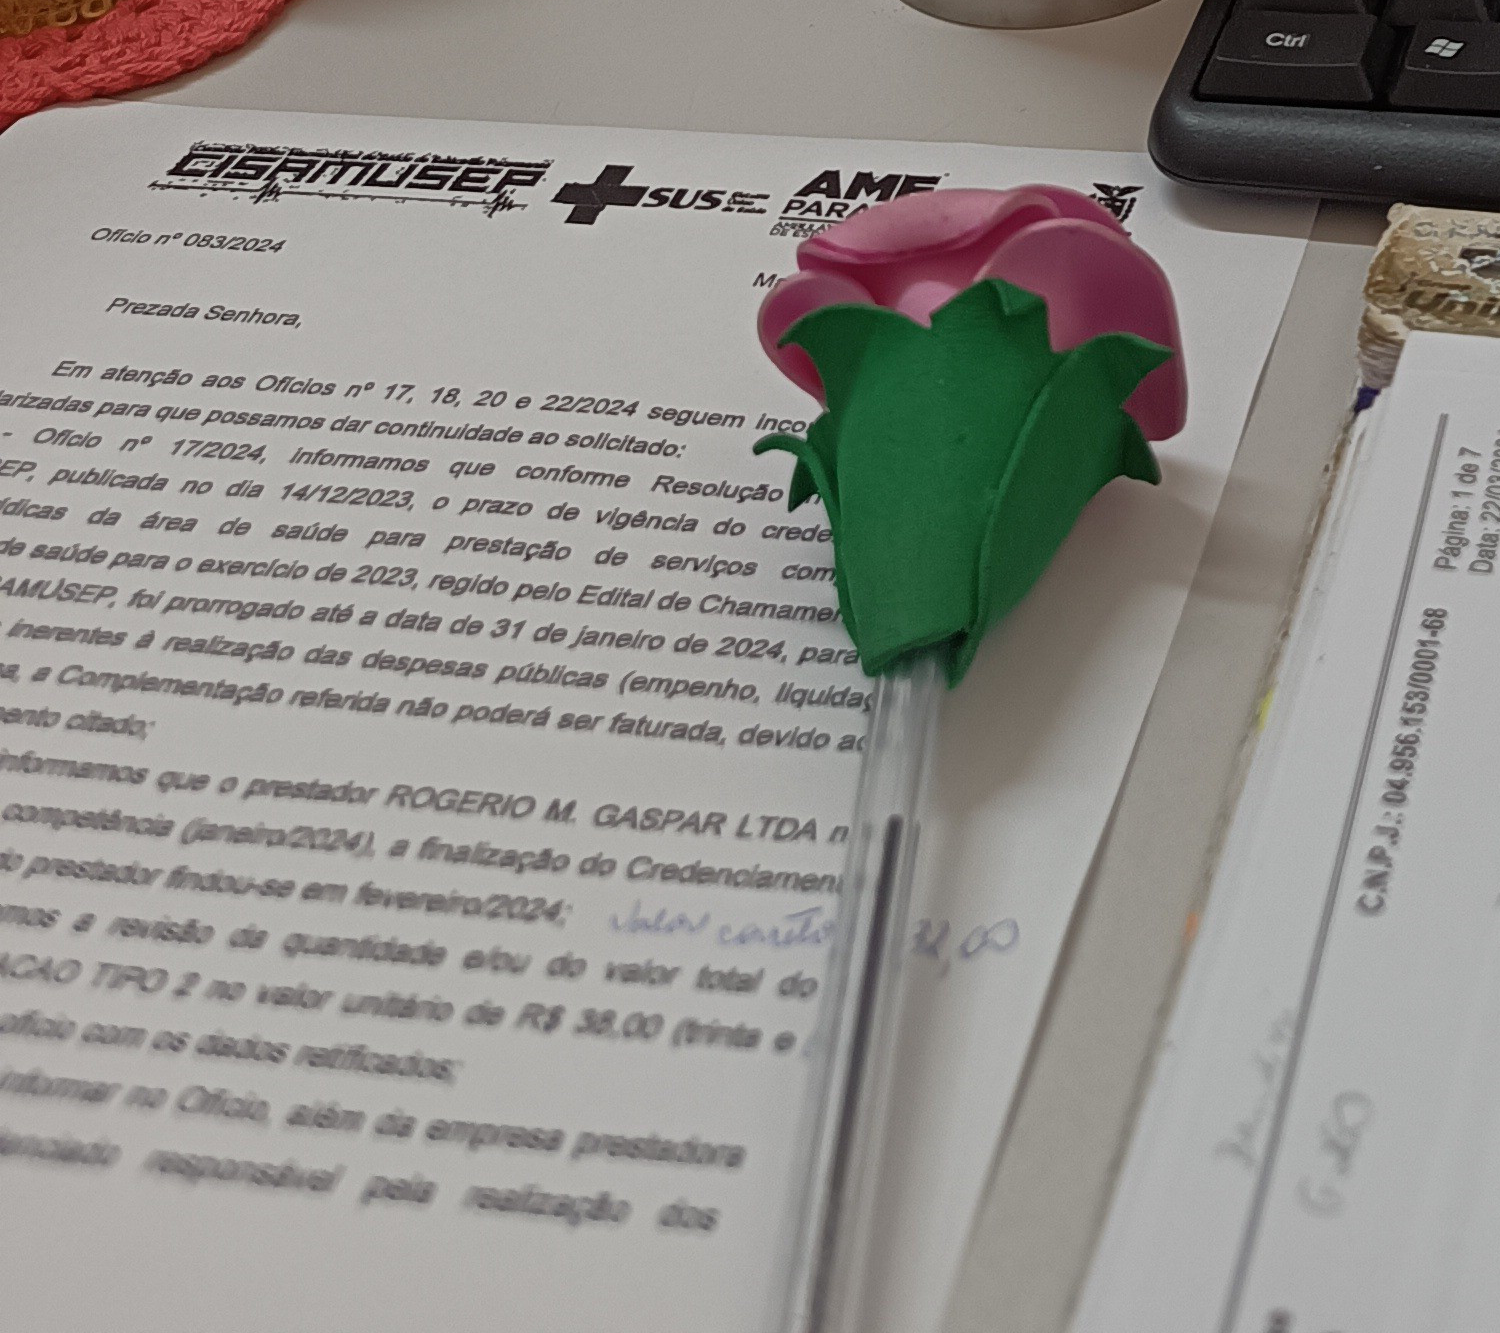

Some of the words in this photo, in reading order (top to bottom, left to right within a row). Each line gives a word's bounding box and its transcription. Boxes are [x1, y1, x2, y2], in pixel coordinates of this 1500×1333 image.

[1265, 31, 1308, 48] Ctrl
[641, 187, 727, 211] SUS
[89, 227, 152, 245] Ofício
[183, 233, 287, 254] 083/2024
[105, 297, 200, 320] Prezada
[204, 305, 303, 329] Senhora,
[51, 360, 92, 379] Em
[100, 365, 193, 387] atenção
[201, 373, 246, 389] aos
[256, 375, 336, 397] Ofícios
[384, 383, 414, 404] 17,
[430, 386, 462, 406] 18,
[32, 428, 102, 449] Ofício
[171, 439, 268, 464] 17/2024,
[289, 446, 430, 473] informamos
[1457, 447, 1482, 457] 7
[1454, 463, 1480, 484] de
[48, 467, 168, 491] publicada
[180, 478, 214, 494] no
[225, 480, 265, 498] dia
[281, 482, 415, 511] 14/12/2023,
[432, 496, 449, 510] o
[1432, 505, 1470, 570] Página:
